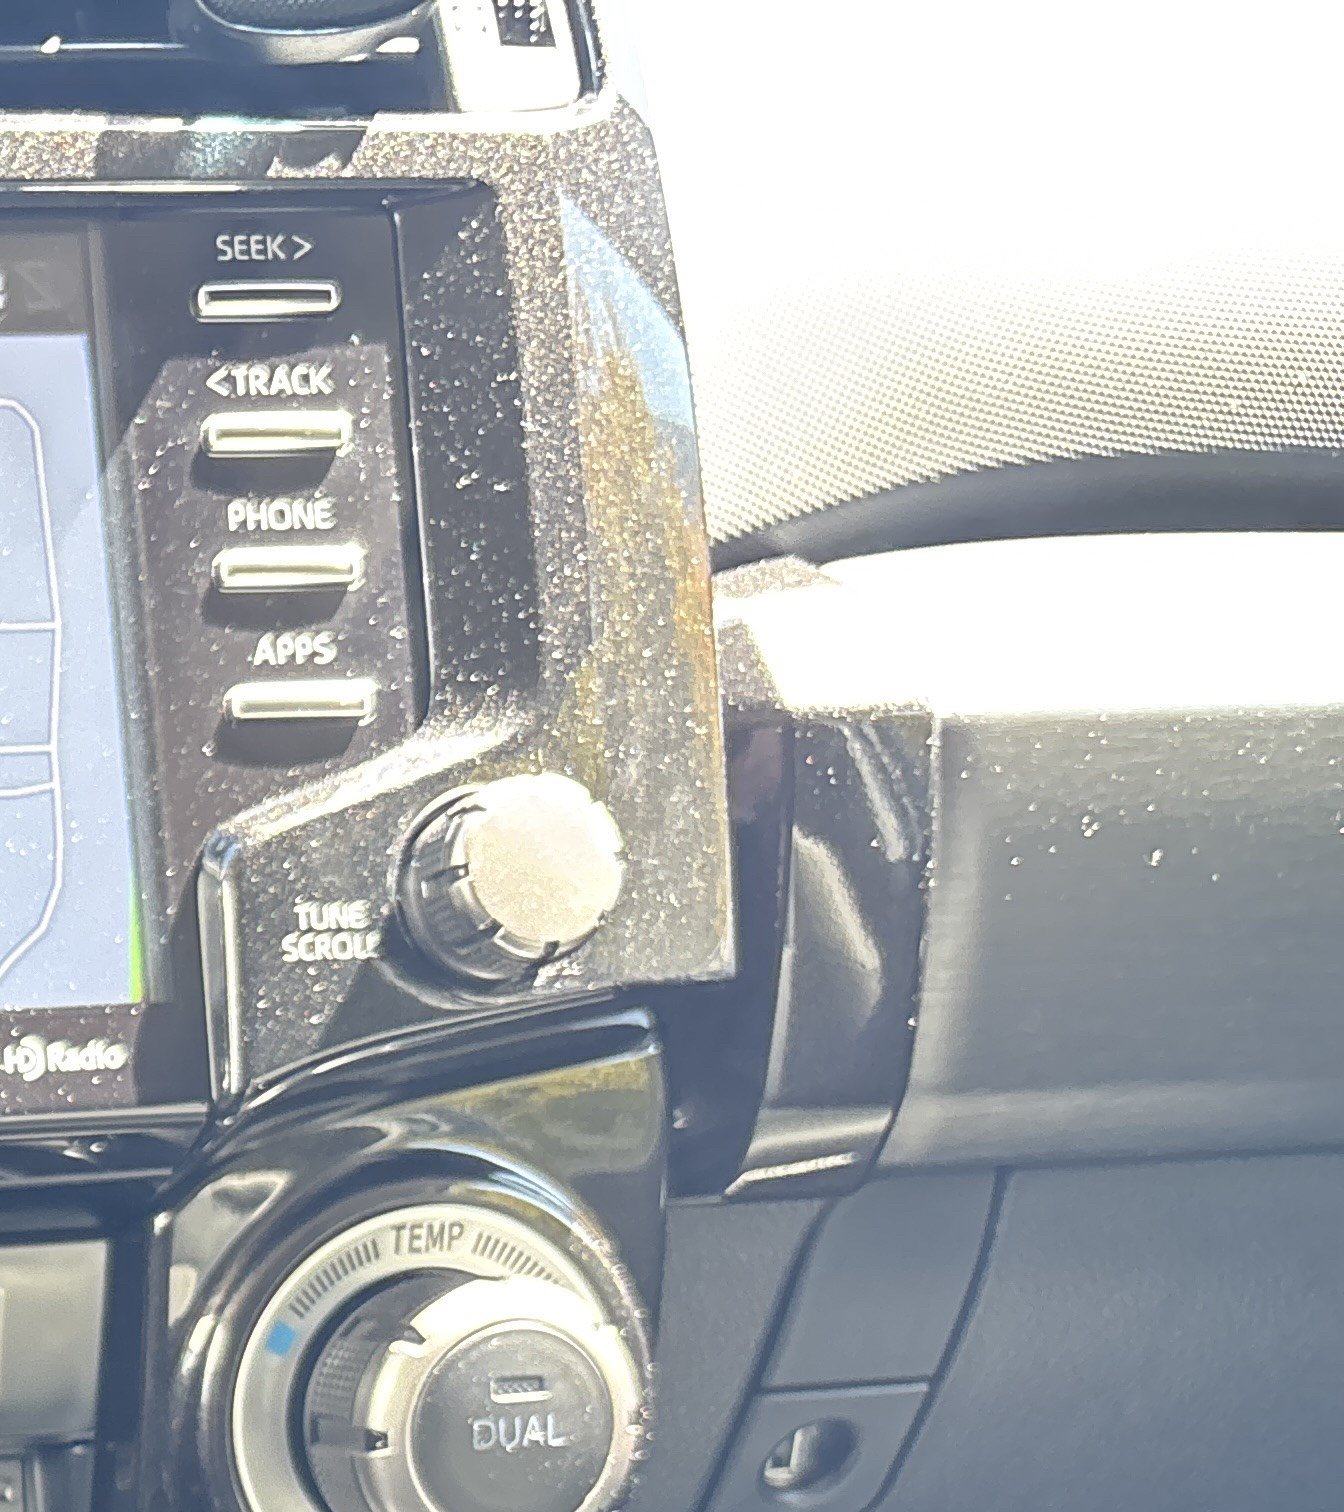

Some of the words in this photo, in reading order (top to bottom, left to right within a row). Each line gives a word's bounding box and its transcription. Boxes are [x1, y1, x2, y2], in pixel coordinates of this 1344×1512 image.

[226, 500, 335, 532] PHONE
[253, 633, 337, 666] APPS
[293, 899, 372, 931] TUNE
[281, 930, 381, 963] SCROLL
[390, 1222, 465, 1256] TEMP
[471, 1415, 567, 1452] DUAL
